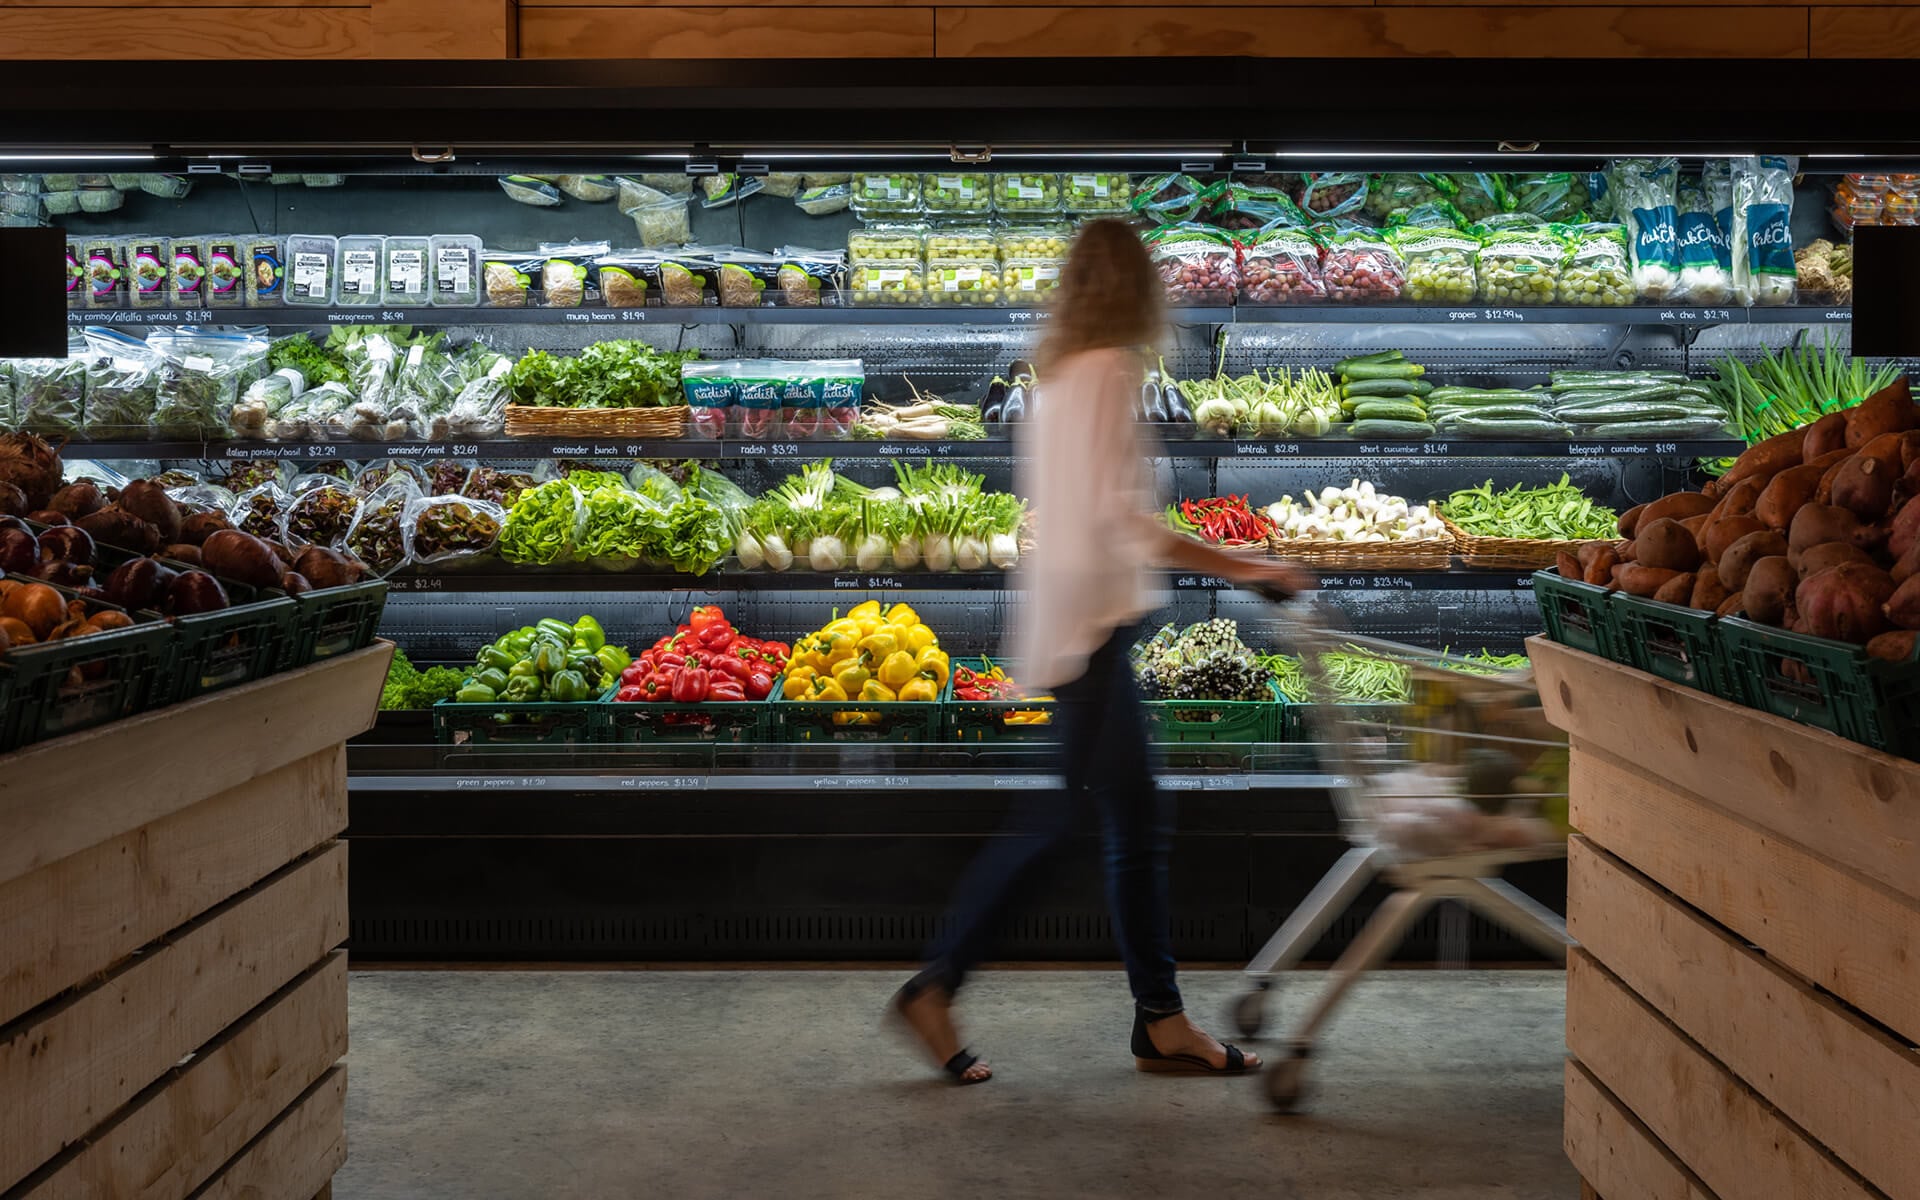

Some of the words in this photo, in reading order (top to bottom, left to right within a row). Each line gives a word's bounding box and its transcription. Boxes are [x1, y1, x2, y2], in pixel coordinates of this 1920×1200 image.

[1752, 223, 1792, 247] PakCh
[67, 314, 82, 322] chy
[147, 312, 178, 322] sprouts
[185, 310, 212, 322] $1.99
[328, 312, 375, 324] microgreens
[382, 311, 404, 321] $6.99
[566, 312, 589, 322] mung
[592, 311, 616, 320] beans
[622, 311, 645, 321] $1.99
[1009, 312, 1031, 322] grape
[1449, 311, 1477, 321] grapes
[1660, 311, 1675, 321] pak
[1679, 311, 1696, 319] choi
[1703, 310, 1729, 320] $2.79
[1825, 311, 1852, 319] celeria
[783, 385, 817, 400] adish
[822, 385, 855, 400] adish
[226, 447, 249, 457] italian
[308, 446, 337, 457] $2.29
[388, 445, 445, 457] coriander/mint
[452, 444, 478, 456] $2.69
[553, 445, 589, 454] coriander
[594, 445, 618, 455] bunch
[741, 445, 766, 454] radish
[771, 444, 798, 455] $3.29
[879, 445, 902, 454] daikon
[906, 446, 930, 455] radish
[1274, 444, 1299, 455] $2.89
[1383, 445, 1419, 454] cucumber
[1424, 443, 1448, 454] $1.49
[1569, 444, 1604, 456] telegraph
[1610, 445, 1648, 454] cucumber
[1656, 443, 1676, 453] $1.99
[415, 578, 442, 589] $2.49
[834, 577, 859, 588] fennel
[1178, 577, 1197, 586] chilli
[1321, 577, 1343, 588] garlic
[1517, 578, 1535, 586] sno
[456, 779, 480, 788] green
[483, 779, 515, 788] peppers
[621, 778, 635, 786] red
[814, 777, 839, 788] yellow
